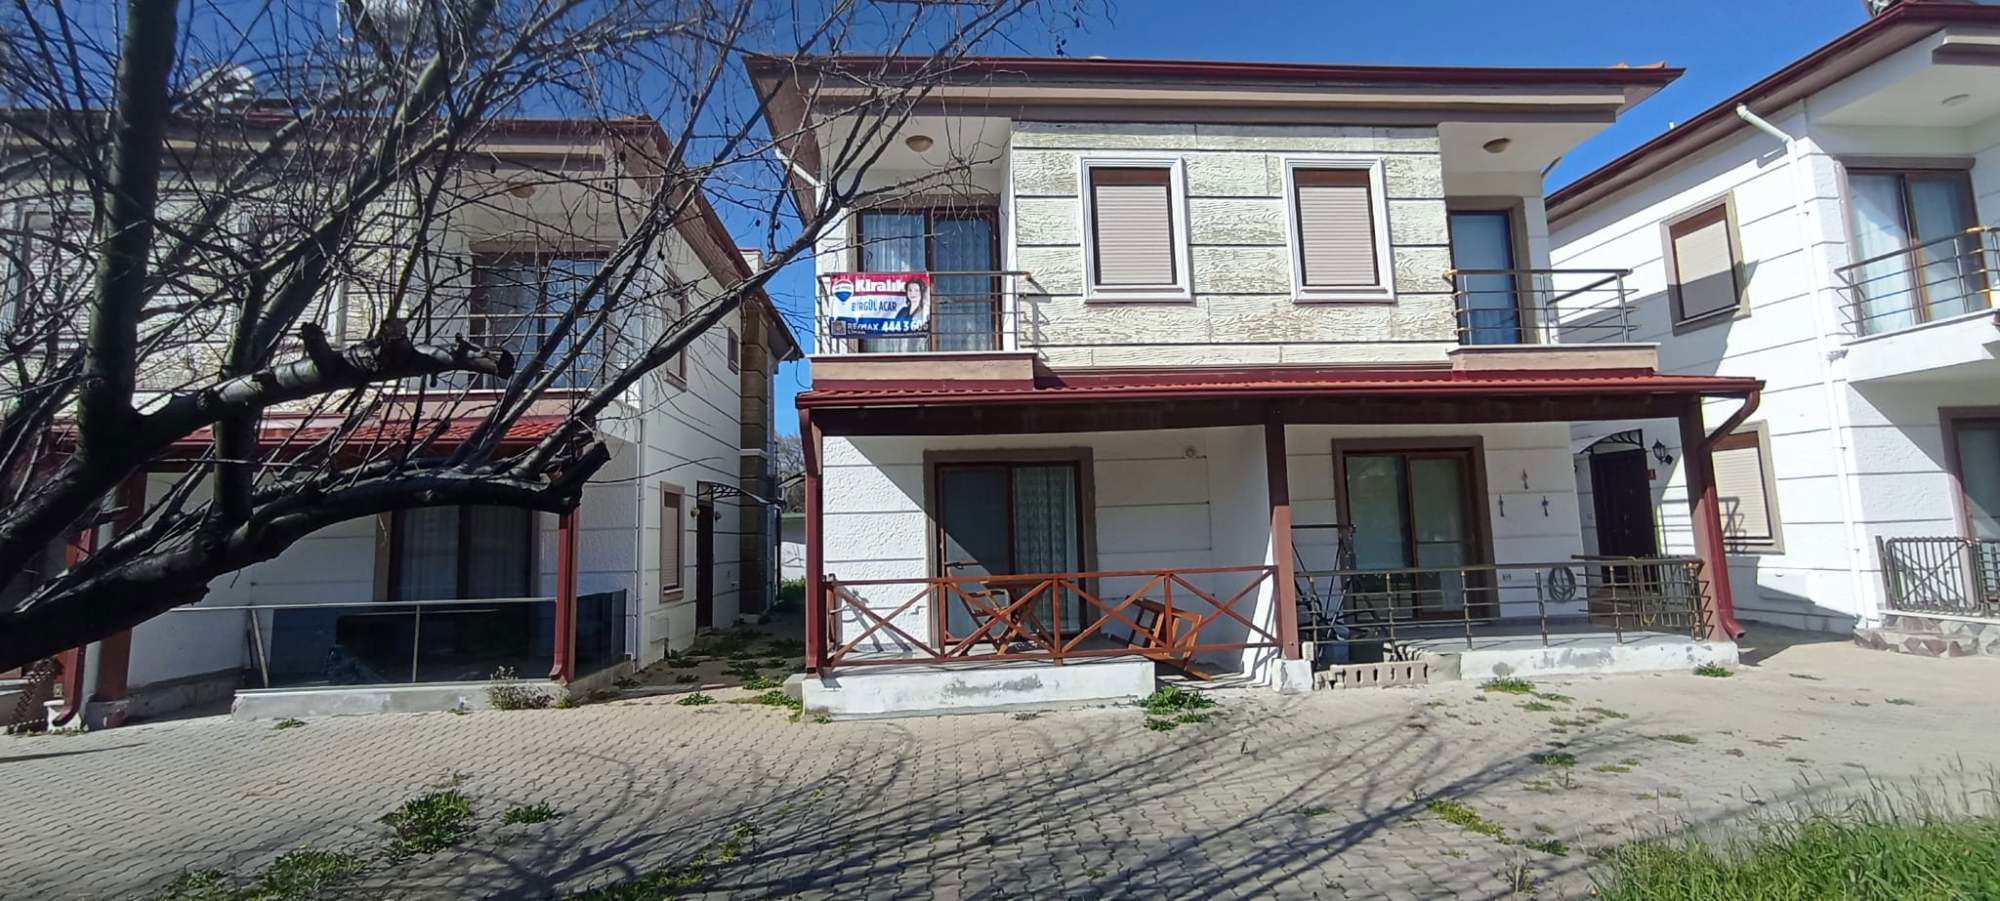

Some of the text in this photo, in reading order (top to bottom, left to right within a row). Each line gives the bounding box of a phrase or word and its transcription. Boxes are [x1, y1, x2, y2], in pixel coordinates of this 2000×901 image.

[855, 279, 906, 292] Kiralık
[879, 301, 897, 312] ACAR
[881, 321, 901, 333] 444
[903, 321, 909, 332] 3
